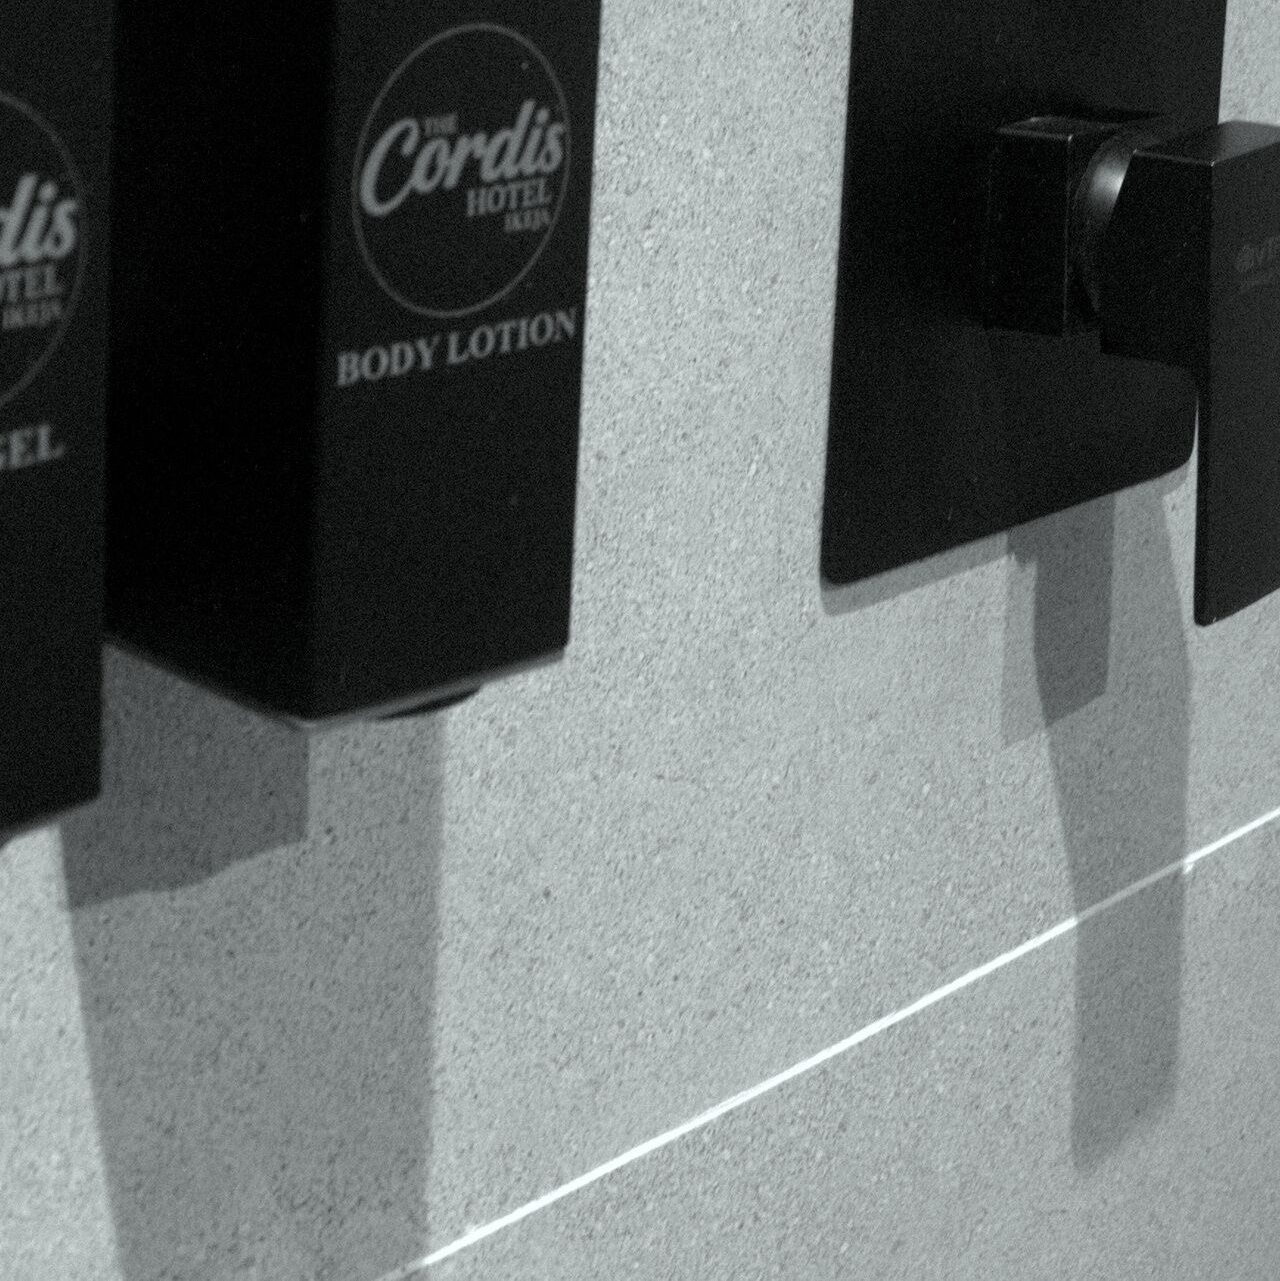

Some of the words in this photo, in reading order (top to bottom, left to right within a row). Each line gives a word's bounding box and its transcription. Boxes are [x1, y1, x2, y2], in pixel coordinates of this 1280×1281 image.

[360, 99, 564, 216] Cordis
[466, 179, 551, 217] HOTEL
[336, 334, 441, 387] BODY
[446, 309, 577, 365] LOTION
